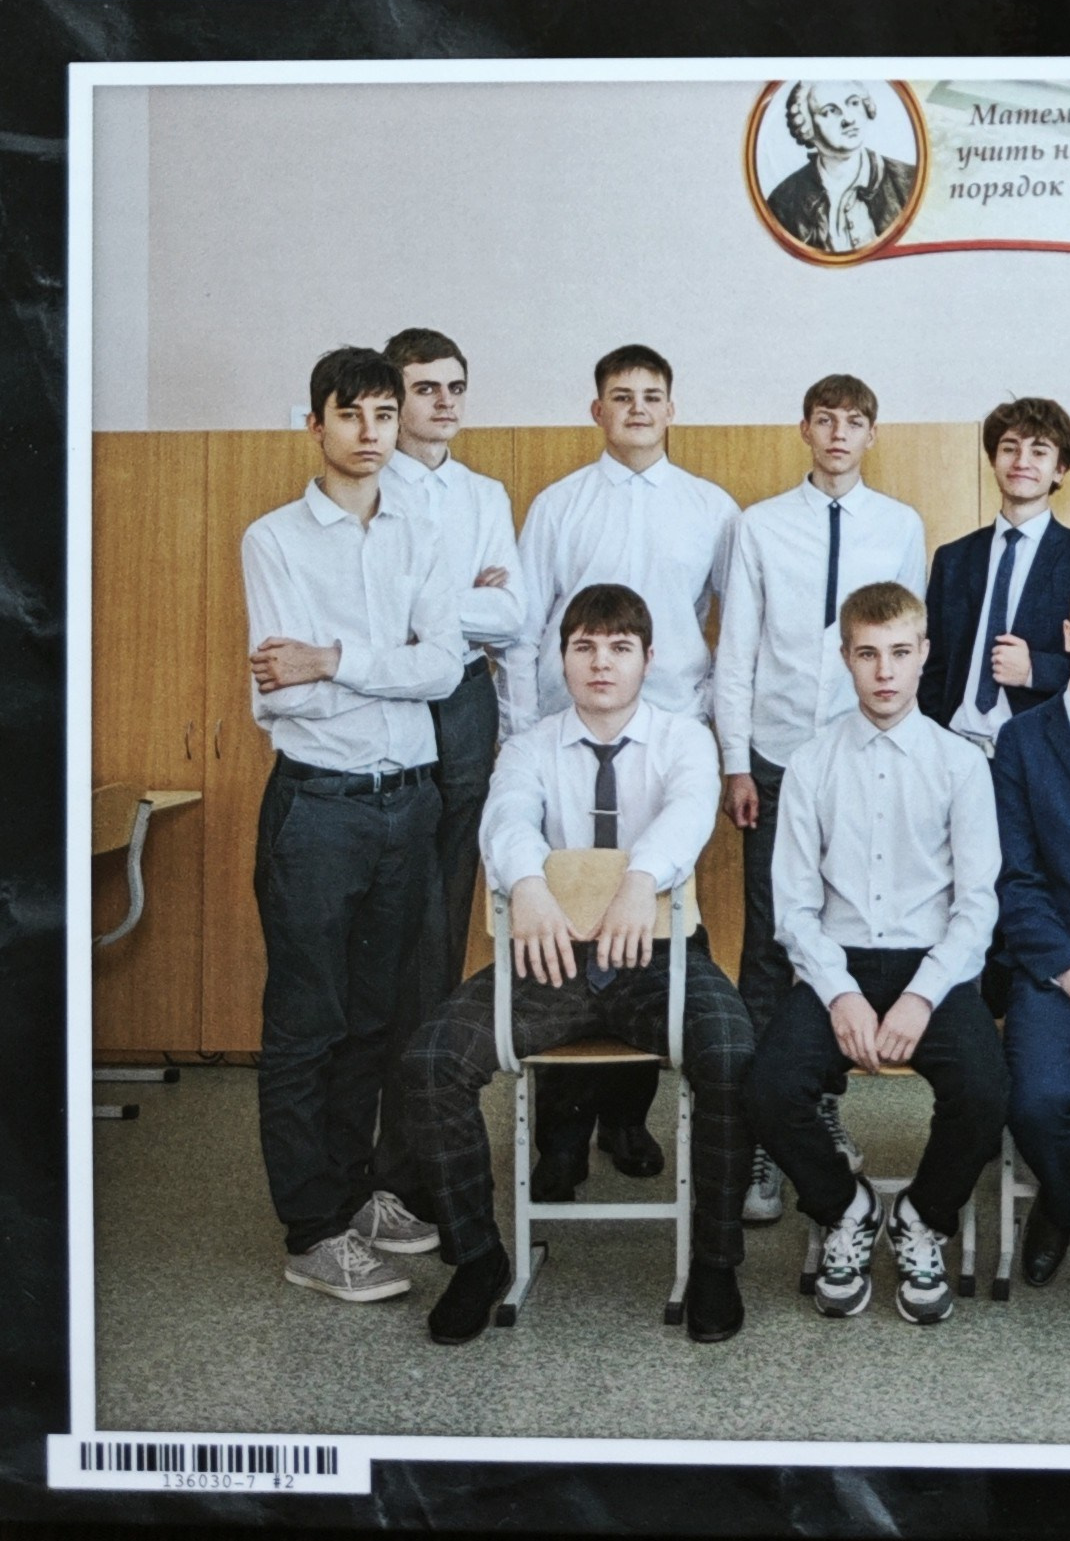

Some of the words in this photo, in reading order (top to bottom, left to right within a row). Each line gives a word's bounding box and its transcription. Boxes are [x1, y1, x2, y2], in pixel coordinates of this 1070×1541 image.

[956, 142, 1045, 171] учить
[950, 174, 1065, 206] порядок
[162, 1473, 256, 1489] 136030-7
[272, 1474, 295, 1489] #2
